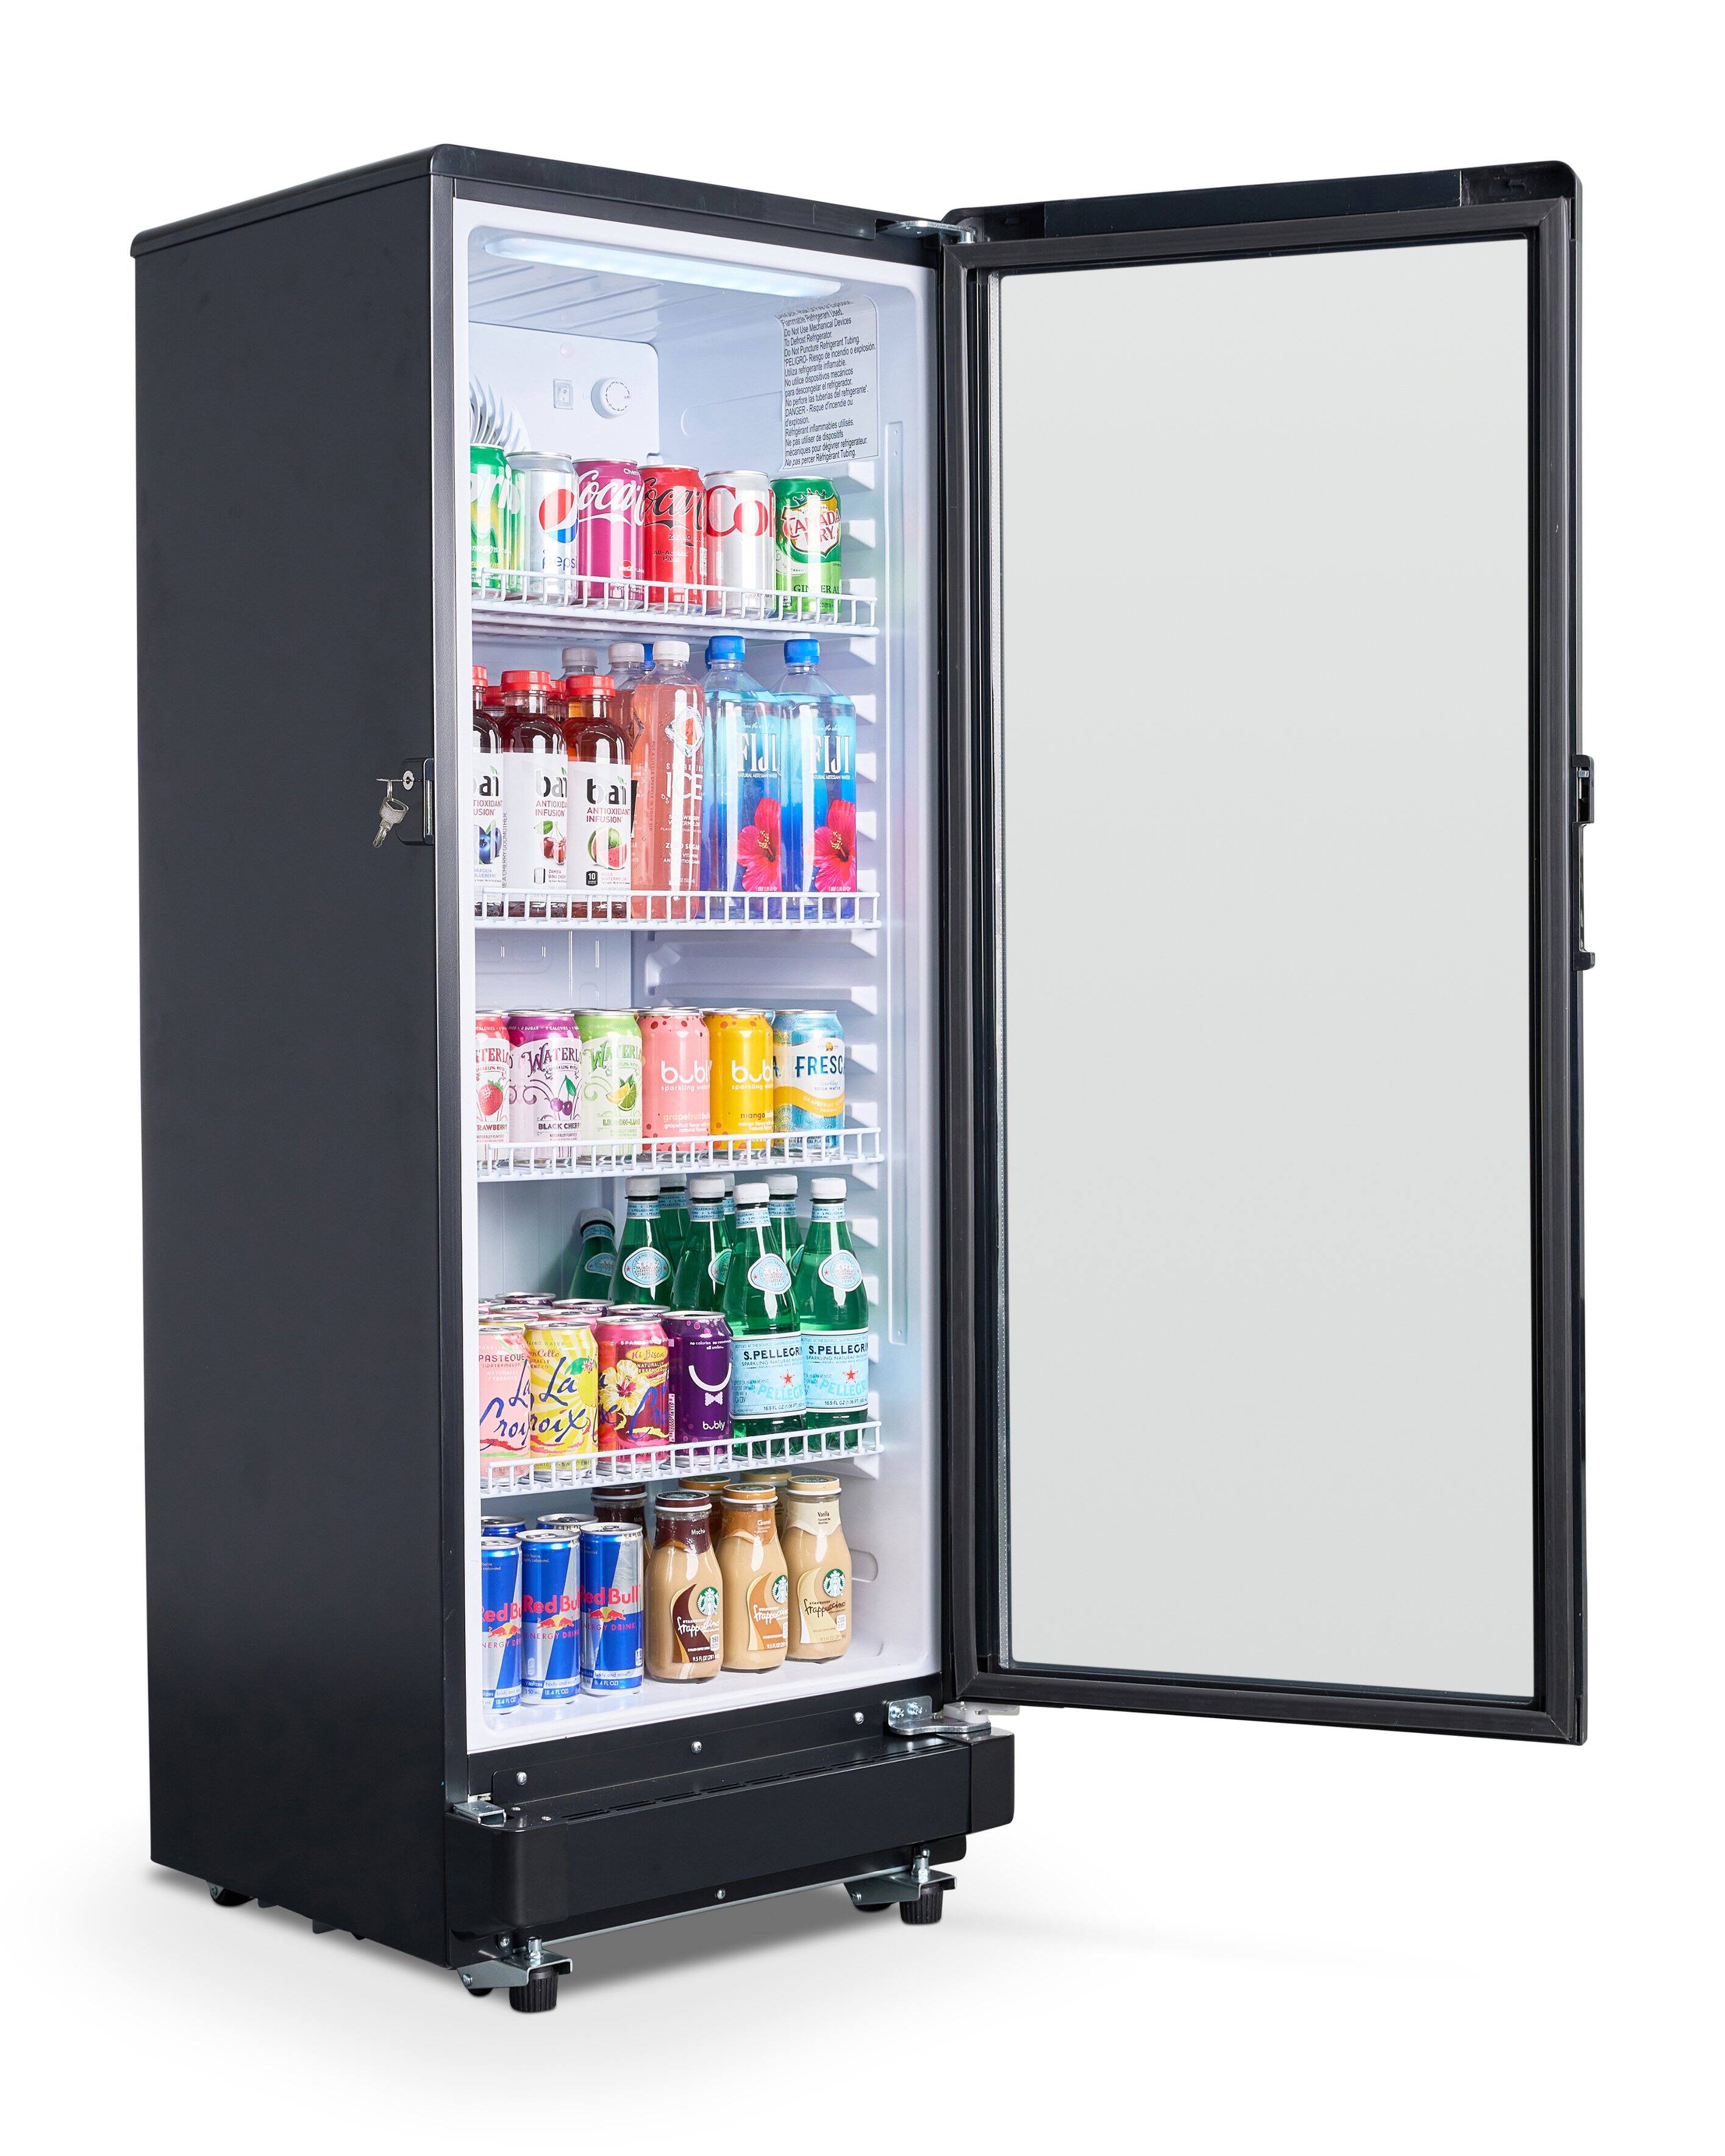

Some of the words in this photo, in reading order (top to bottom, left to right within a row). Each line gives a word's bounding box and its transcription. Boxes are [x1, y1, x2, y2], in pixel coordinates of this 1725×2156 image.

[782, 316, 805, 327] Flammable
[806, 310, 830, 322] Refrigerant
[830, 308, 844, 316] Used.
[784, 329, 790, 337] Do
[810, 321, 834, 332] Mechanical
[834, 317, 852, 327] Devices
[791, 335, 805, 346] Defrost
[807, 331, 832, 343] Refrigerator.
[800, 344, 819, 354] Puncture
[820, 340, 843, 351] Refrigerant
[845, 335, 860, 345] Tubing.
[809, 352, 824, 363] Riesgo
[831, 348, 849, 358] incendio
[854, 343, 876, 355] explosión.
[784, 368, 798, 377] Utiliza
[798, 363, 823, 375] refrigerante
[823, 359, 846, 369] inflamable.
[792, 376, 804, 385] utilice
[805, 373, 830, 383] dispositivos
[830, 368, 854, 378] mecánicos
[796, 384, 821, 394] descongelar
[827, 378, 852, 389] refrigerador.
[785, 407, 805, 416] DANGER
[809, 404, 824, 413] Risque
[825, 401, 846, 410] d'incendie
[793, 396, 807, 406] perfore
[785, 417, 809, 427] d'explosion.
[809, 422, 837, 433] inflammables
[838, 418, 854, 427] utilisés.
[801, 435, 815, 444] utiliser
[823, 430, 844, 441] dispositifs
[785, 447, 810, 457] mécaniques
[812, 444, 821, 453] pour
[822, 441, 840, 452] dégivrer
[792, 458, 801, 466] pas
[801, 456, 815, 466] percer
[840, 449, 857, 458] Tubing.
[707, 485, 776, 538] Co
[737, 733, 777, 771] FIJI
[809, 735, 850, 774] FIJI
[587, 779, 626, 805] bai
[666, 772, 703, 801] ICE
[587, 807, 630, 815] ANTIOXIDANT
[795, 1055, 845, 1077] FRESC
[509, 1359, 530, 1408] La
[539, 1357, 577, 1406] La
[530, 1409, 588, 1442] roix
[702, 1420, 725, 1430] bubly
[524, 1594, 557, 1614] Red
[609, 1585, 638, 1605] Bull
[804, 1598, 846, 1618] frappuccino
[524, 1630, 559, 1640] ENERGY
[677, 1616, 720, 1638] frappuccino
